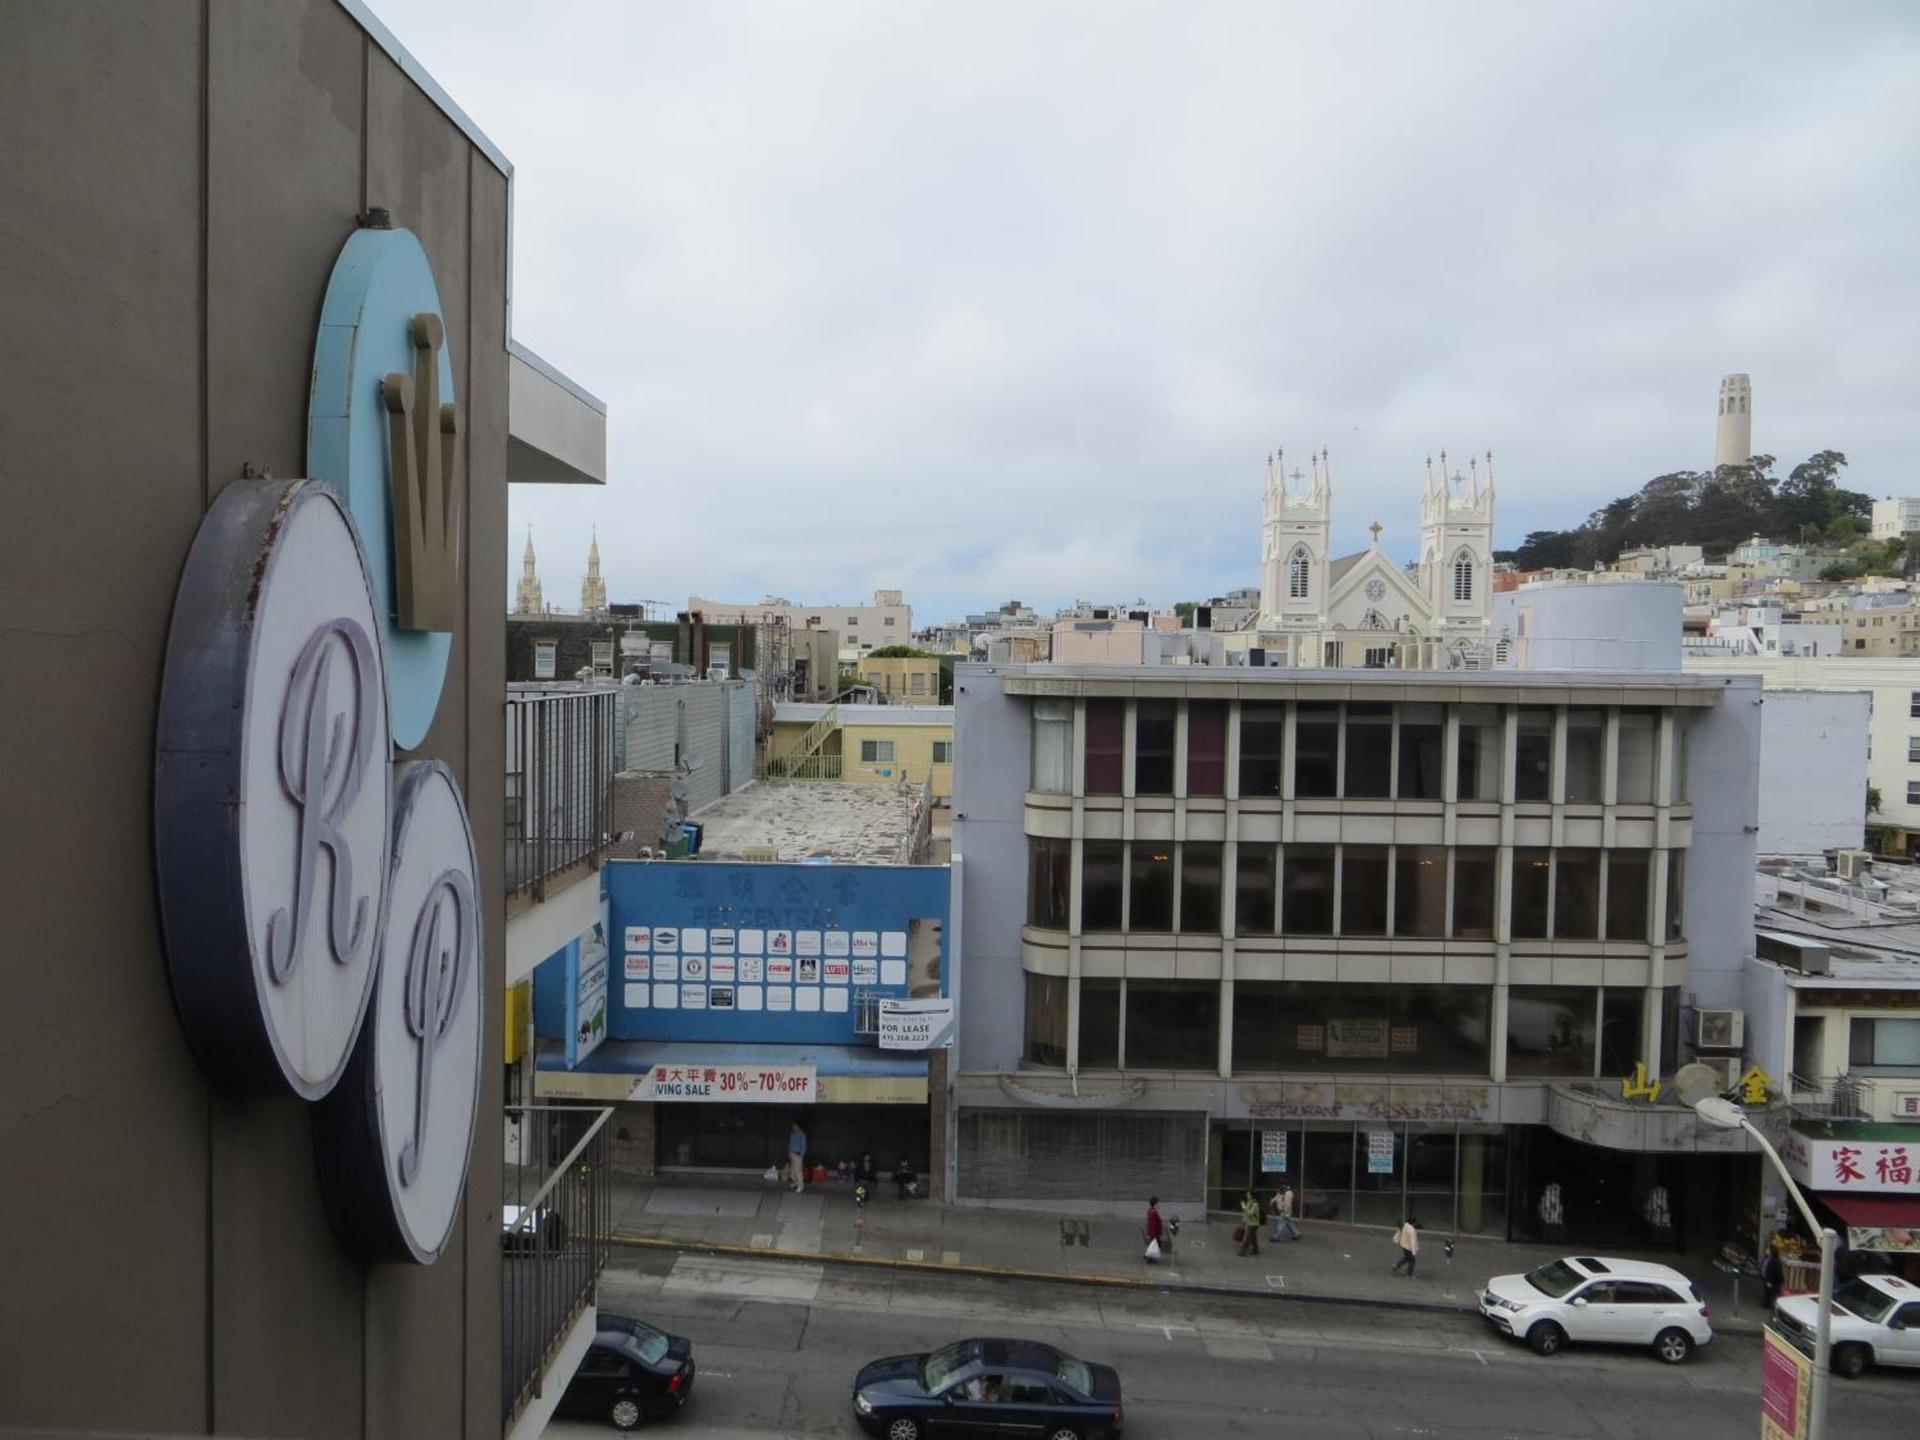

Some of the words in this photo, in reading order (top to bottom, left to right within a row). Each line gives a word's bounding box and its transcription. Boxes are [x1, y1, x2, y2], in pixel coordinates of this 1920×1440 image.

[267, 616, 379, 986] R
[401, 868, 475, 1188] P
[881, 1024, 898, 1033] FOR
[903, 1024, 930, 1033] LEASE
[656, 1084, 682, 1096] VING
[685, 1084, 711, 1096] SALE
[788, 1077, 808, 1091] OFF
[1832, 1146, 1912, 1185] 家福
